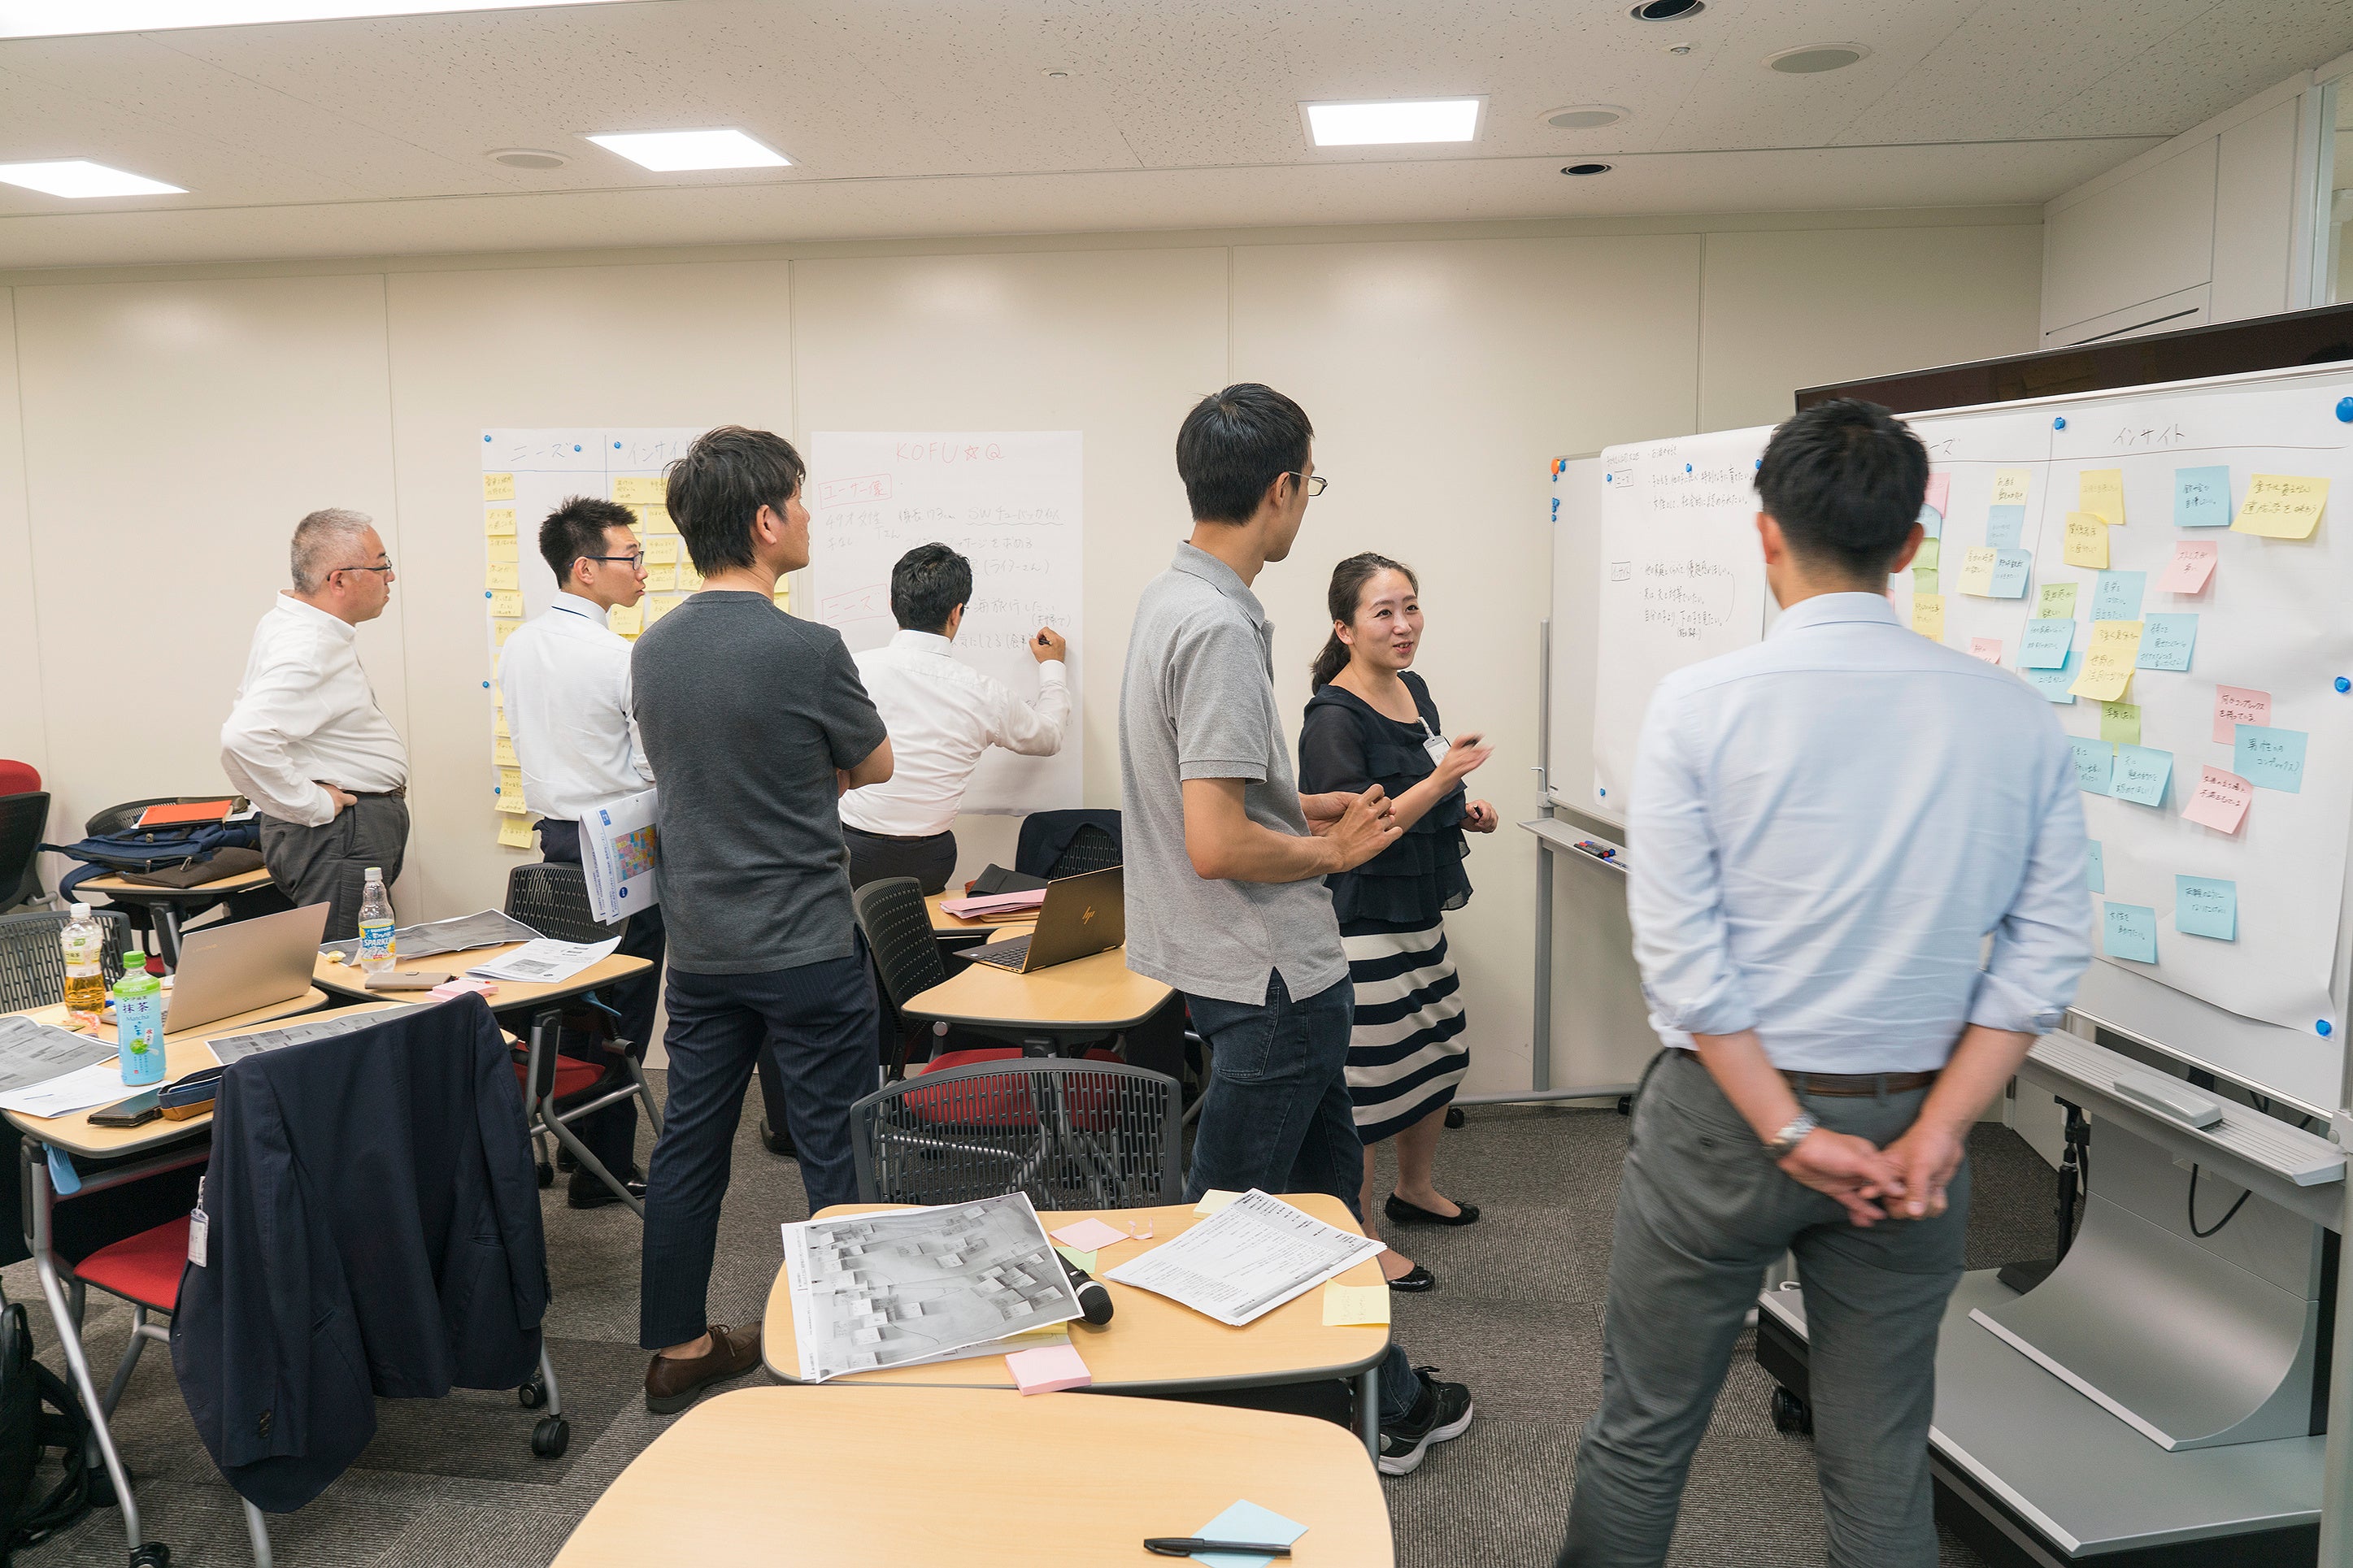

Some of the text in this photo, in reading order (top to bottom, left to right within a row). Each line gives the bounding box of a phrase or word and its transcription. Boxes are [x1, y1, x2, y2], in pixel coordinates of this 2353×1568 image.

[2113, 423, 2185, 445] インサイト
[511, 442, 572, 462] ニーズ
[1920, 438, 1961, 454] ーズ
[824, 480, 888, 500] ユーザー像
[827, 592, 881, 619] ニーズ
[122, 1001, 150, 1014] 抹茶
[126, 1014, 150, 1023] Matcha
